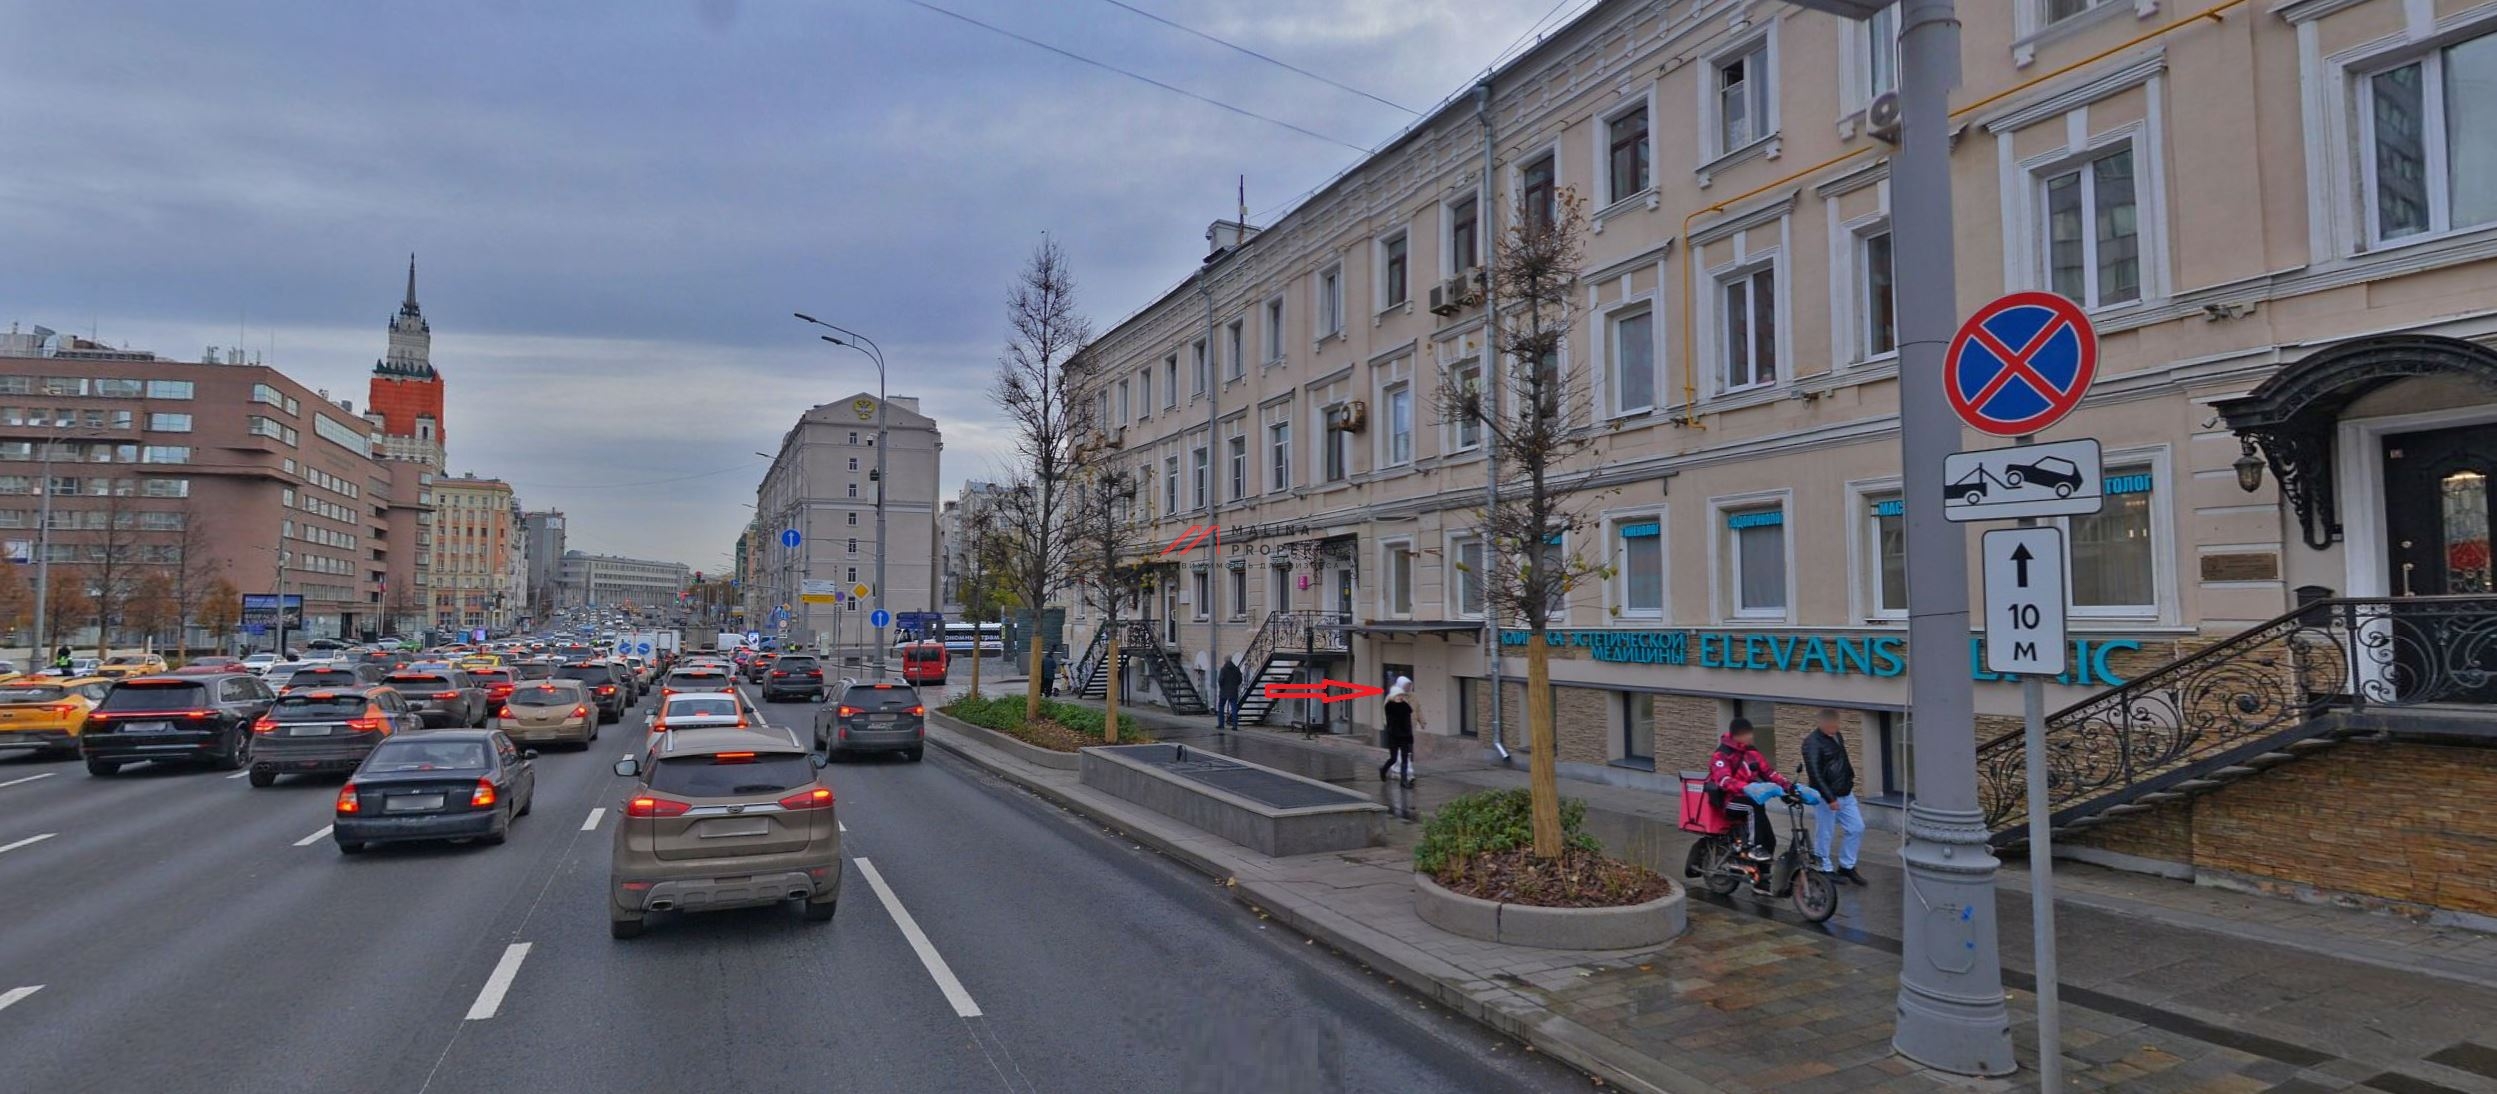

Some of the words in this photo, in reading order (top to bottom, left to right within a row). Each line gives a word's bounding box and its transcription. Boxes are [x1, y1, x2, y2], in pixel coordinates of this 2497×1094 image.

[2104, 474, 2152, 494] ТОЛОГ
[1879, 501, 1904, 515] МАС
[2008, 603, 2040, 630] 10
[1502, 631, 1566, 645] КЛИКА
[1570, 631, 1687, 650] ЭСТЕТИЧЕСКОЙ
[1592, 646, 1687, 665] МЕДИЦИНЫ
[1700, 633, 1906, 678] ELEVANS
[2013, 641, 2037, 662] М
